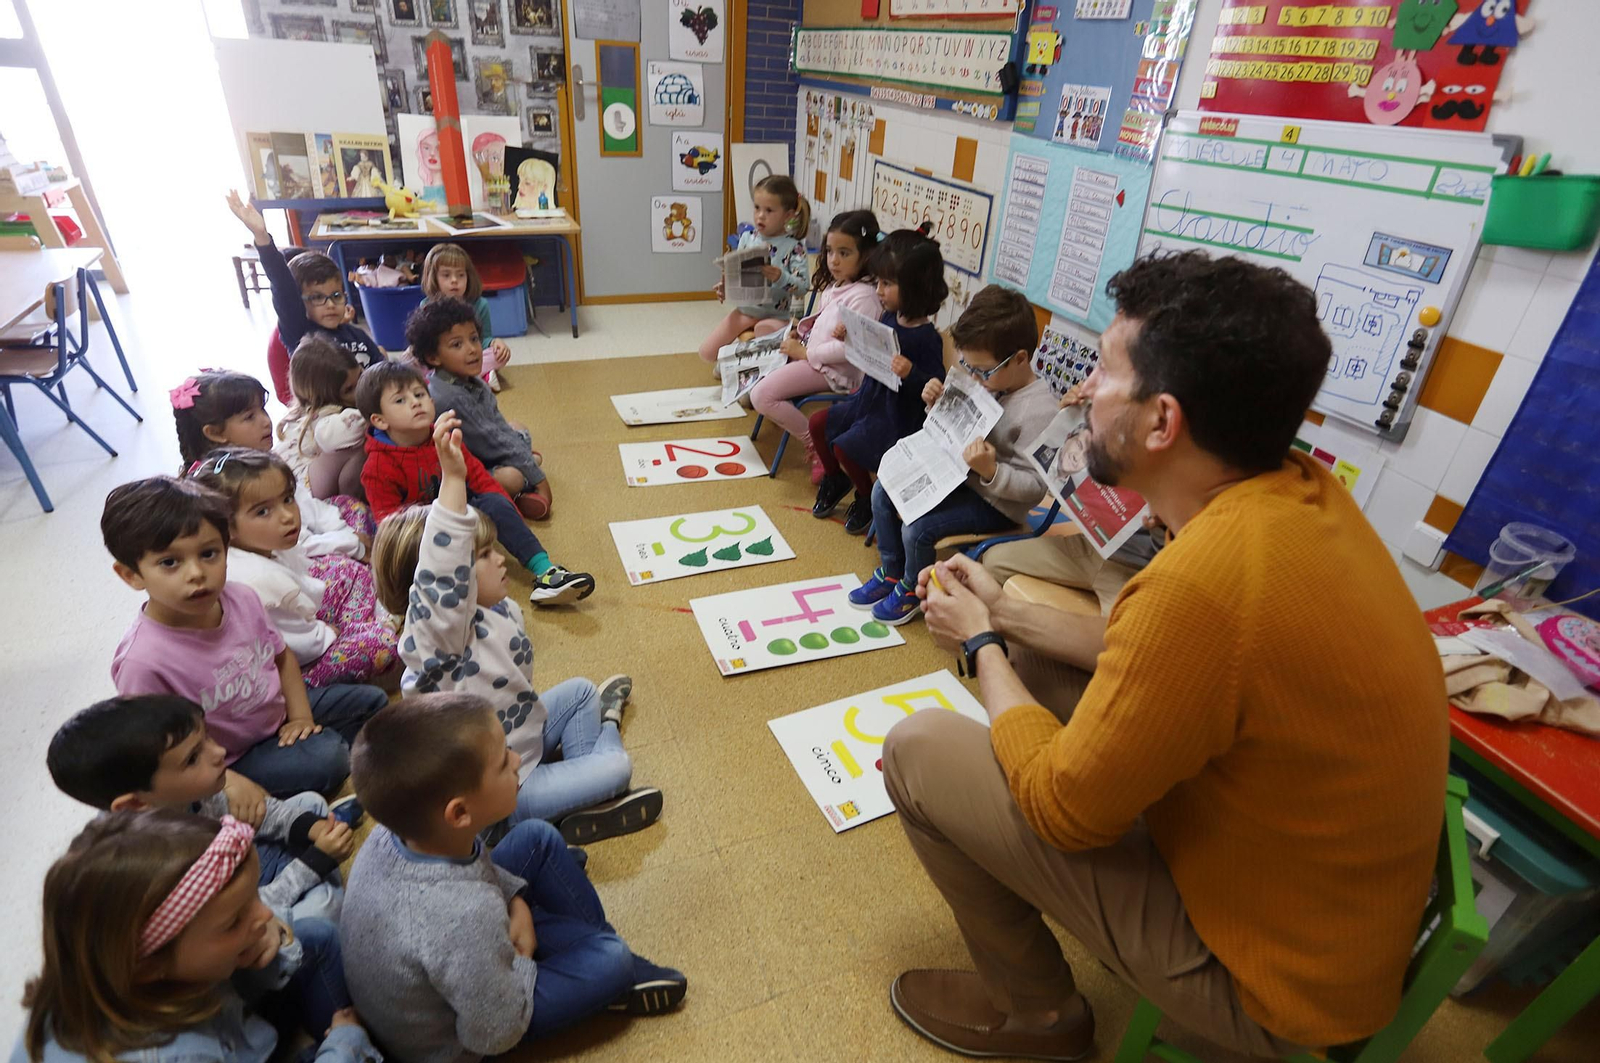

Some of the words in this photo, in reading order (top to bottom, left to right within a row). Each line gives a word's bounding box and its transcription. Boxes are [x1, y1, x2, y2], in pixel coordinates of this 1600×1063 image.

[1252, 7, 1260, 23] 3
[1283, 8, 1292, 24] 5
[1300, 8, 1308, 24] 6
[1318, 8, 1327, 24] 7
[1334, 8, 1343, 25] 8
[1354, 8, 1362, 24] 9
[1370, 10, 1388, 25] 10
[1242, 39, 1254, 52] 13
[1256, 39, 1269, 52] 14
[1273, 40, 1285, 53] 15
[1288, 40, 1301, 53] 16
[1305, 40, 1318, 55] 17
[1322, 41, 1336, 56] 18
[1340, 42, 1355, 57] 19
[1356, 42, 1375, 58] 20
[1220, 62, 1232, 76] 22
[1234, 63, 1248, 77] 23
[1250, 63, 1263, 76] 24
[1266, 64, 1279, 78] 25
[1280, 65, 1294, 79] 26
[1296, 64, 1314, 78] 27
[1314, 66, 1330, 81] 28
[1333, 64, 1350, 80] 29
[1353, 66, 1369, 83] 30
[1285, 128, 1294, 141] 4
[1281, 150, 1296, 170] 4
[1312, 152, 1389, 182] MAYO
[1156, 188, 1322, 256] Claudio
[664, 440, 741, 462] 2
[669, 512, 757, 543] 3
[761, 584, 844, 627] 4
[718, 616, 741, 650] cuatro
[843, 688, 958, 745] 5
[811, 746, 842, 785] cinco
